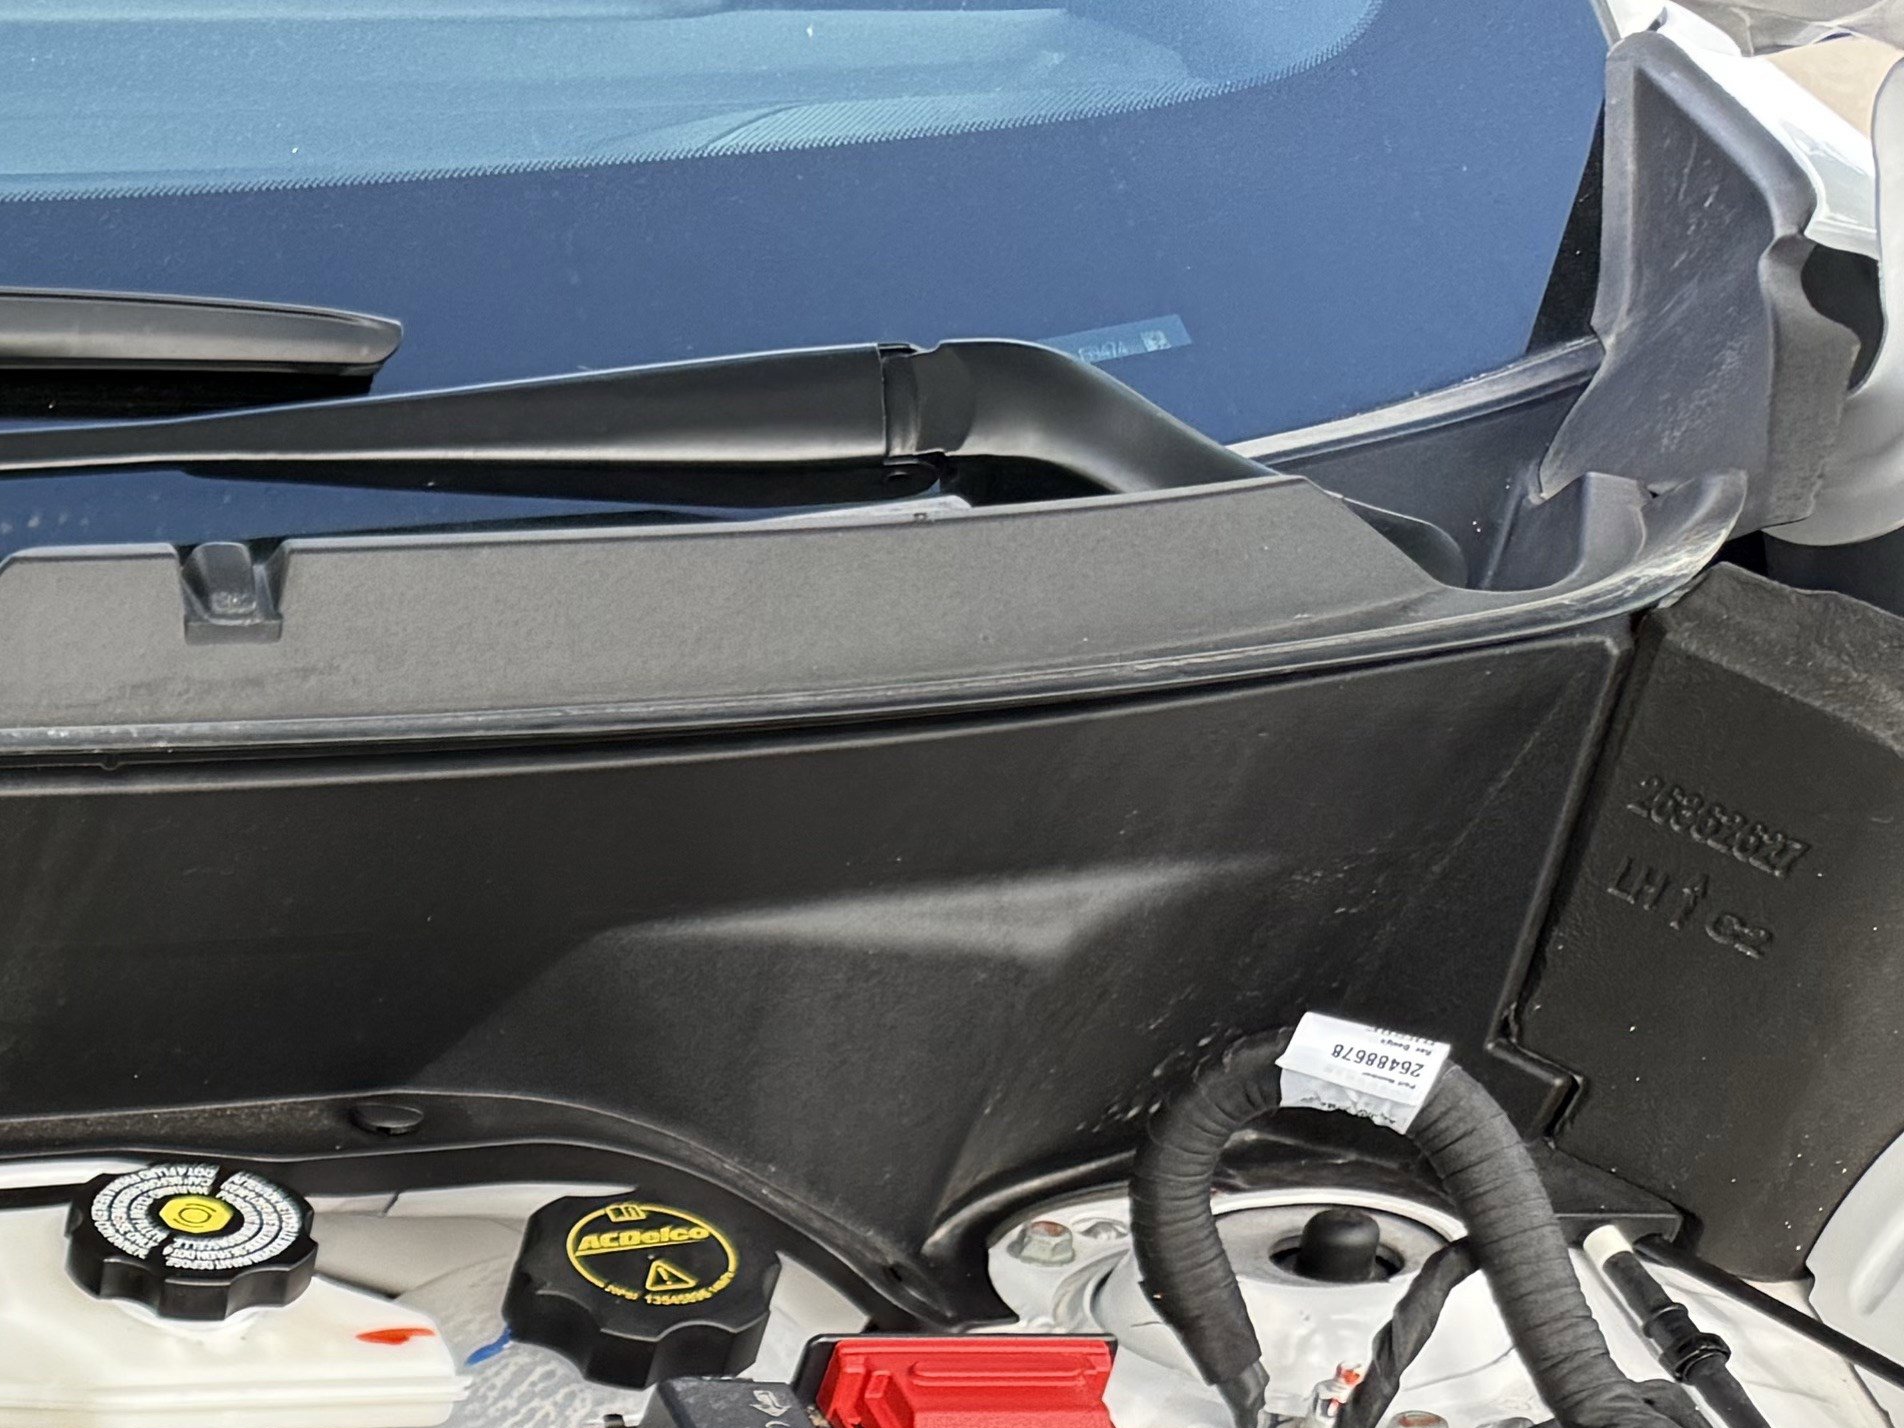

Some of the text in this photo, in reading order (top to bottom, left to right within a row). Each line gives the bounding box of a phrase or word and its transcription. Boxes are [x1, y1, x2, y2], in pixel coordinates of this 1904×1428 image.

[1607, 857, 1671, 911] LH
[1331, 1044, 1425, 1078] 26488678
[577, 1226, 713, 1251] ACDelco
